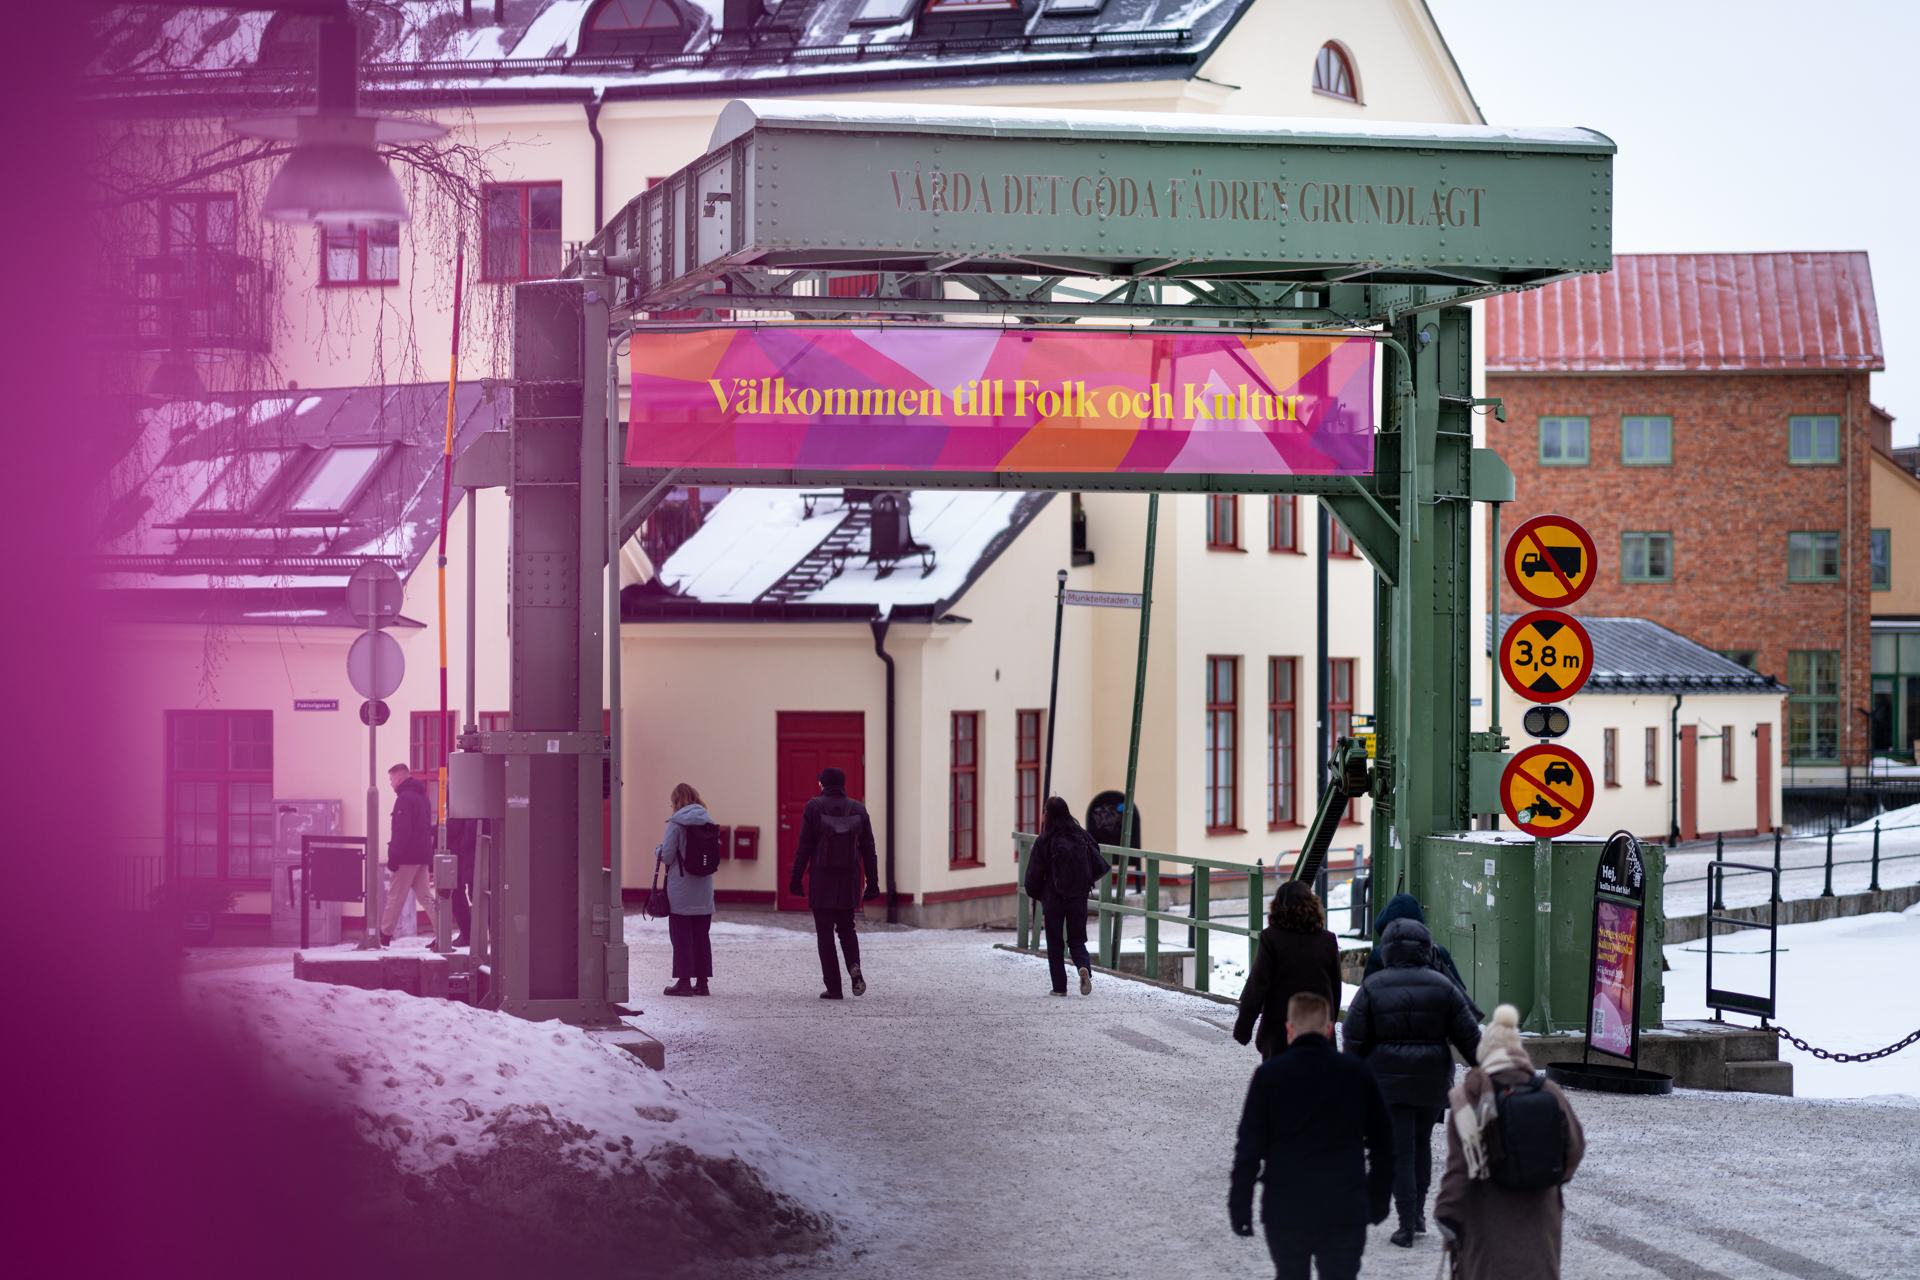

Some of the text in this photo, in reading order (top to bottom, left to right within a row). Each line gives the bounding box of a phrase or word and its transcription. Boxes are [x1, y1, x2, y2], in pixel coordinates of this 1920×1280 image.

[888, 160, 1486, 228] VÅRDA DET GODA FÄDREN GRUNDLAGT
[708, 378, 1305, 421] Välkommen till Folk och Kultur
[1514, 640, 1579, 672] 3,8 m
[1602, 865, 1616, 882] Hej,
